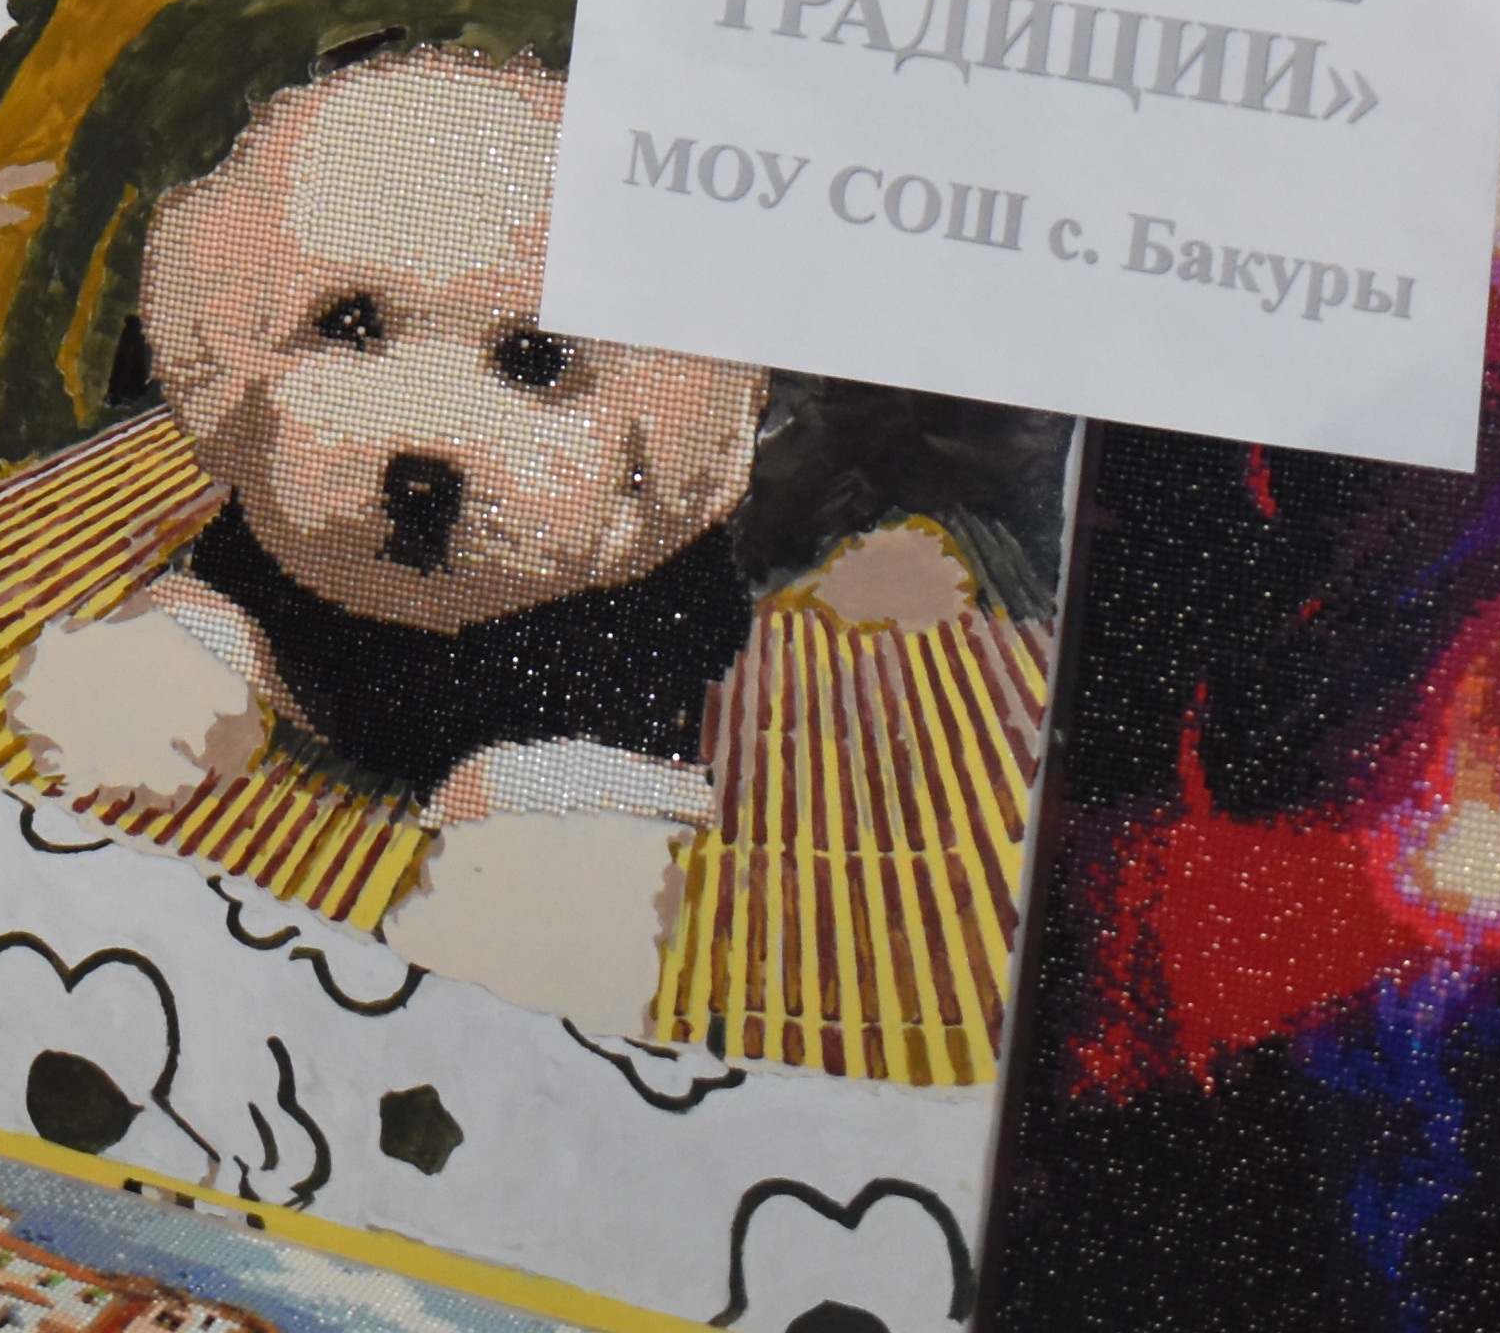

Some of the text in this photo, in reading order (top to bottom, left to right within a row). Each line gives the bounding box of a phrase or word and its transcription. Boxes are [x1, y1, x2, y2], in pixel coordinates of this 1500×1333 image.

[622, 129, 1416, 322] МОУ СОШ с. Бакуры
